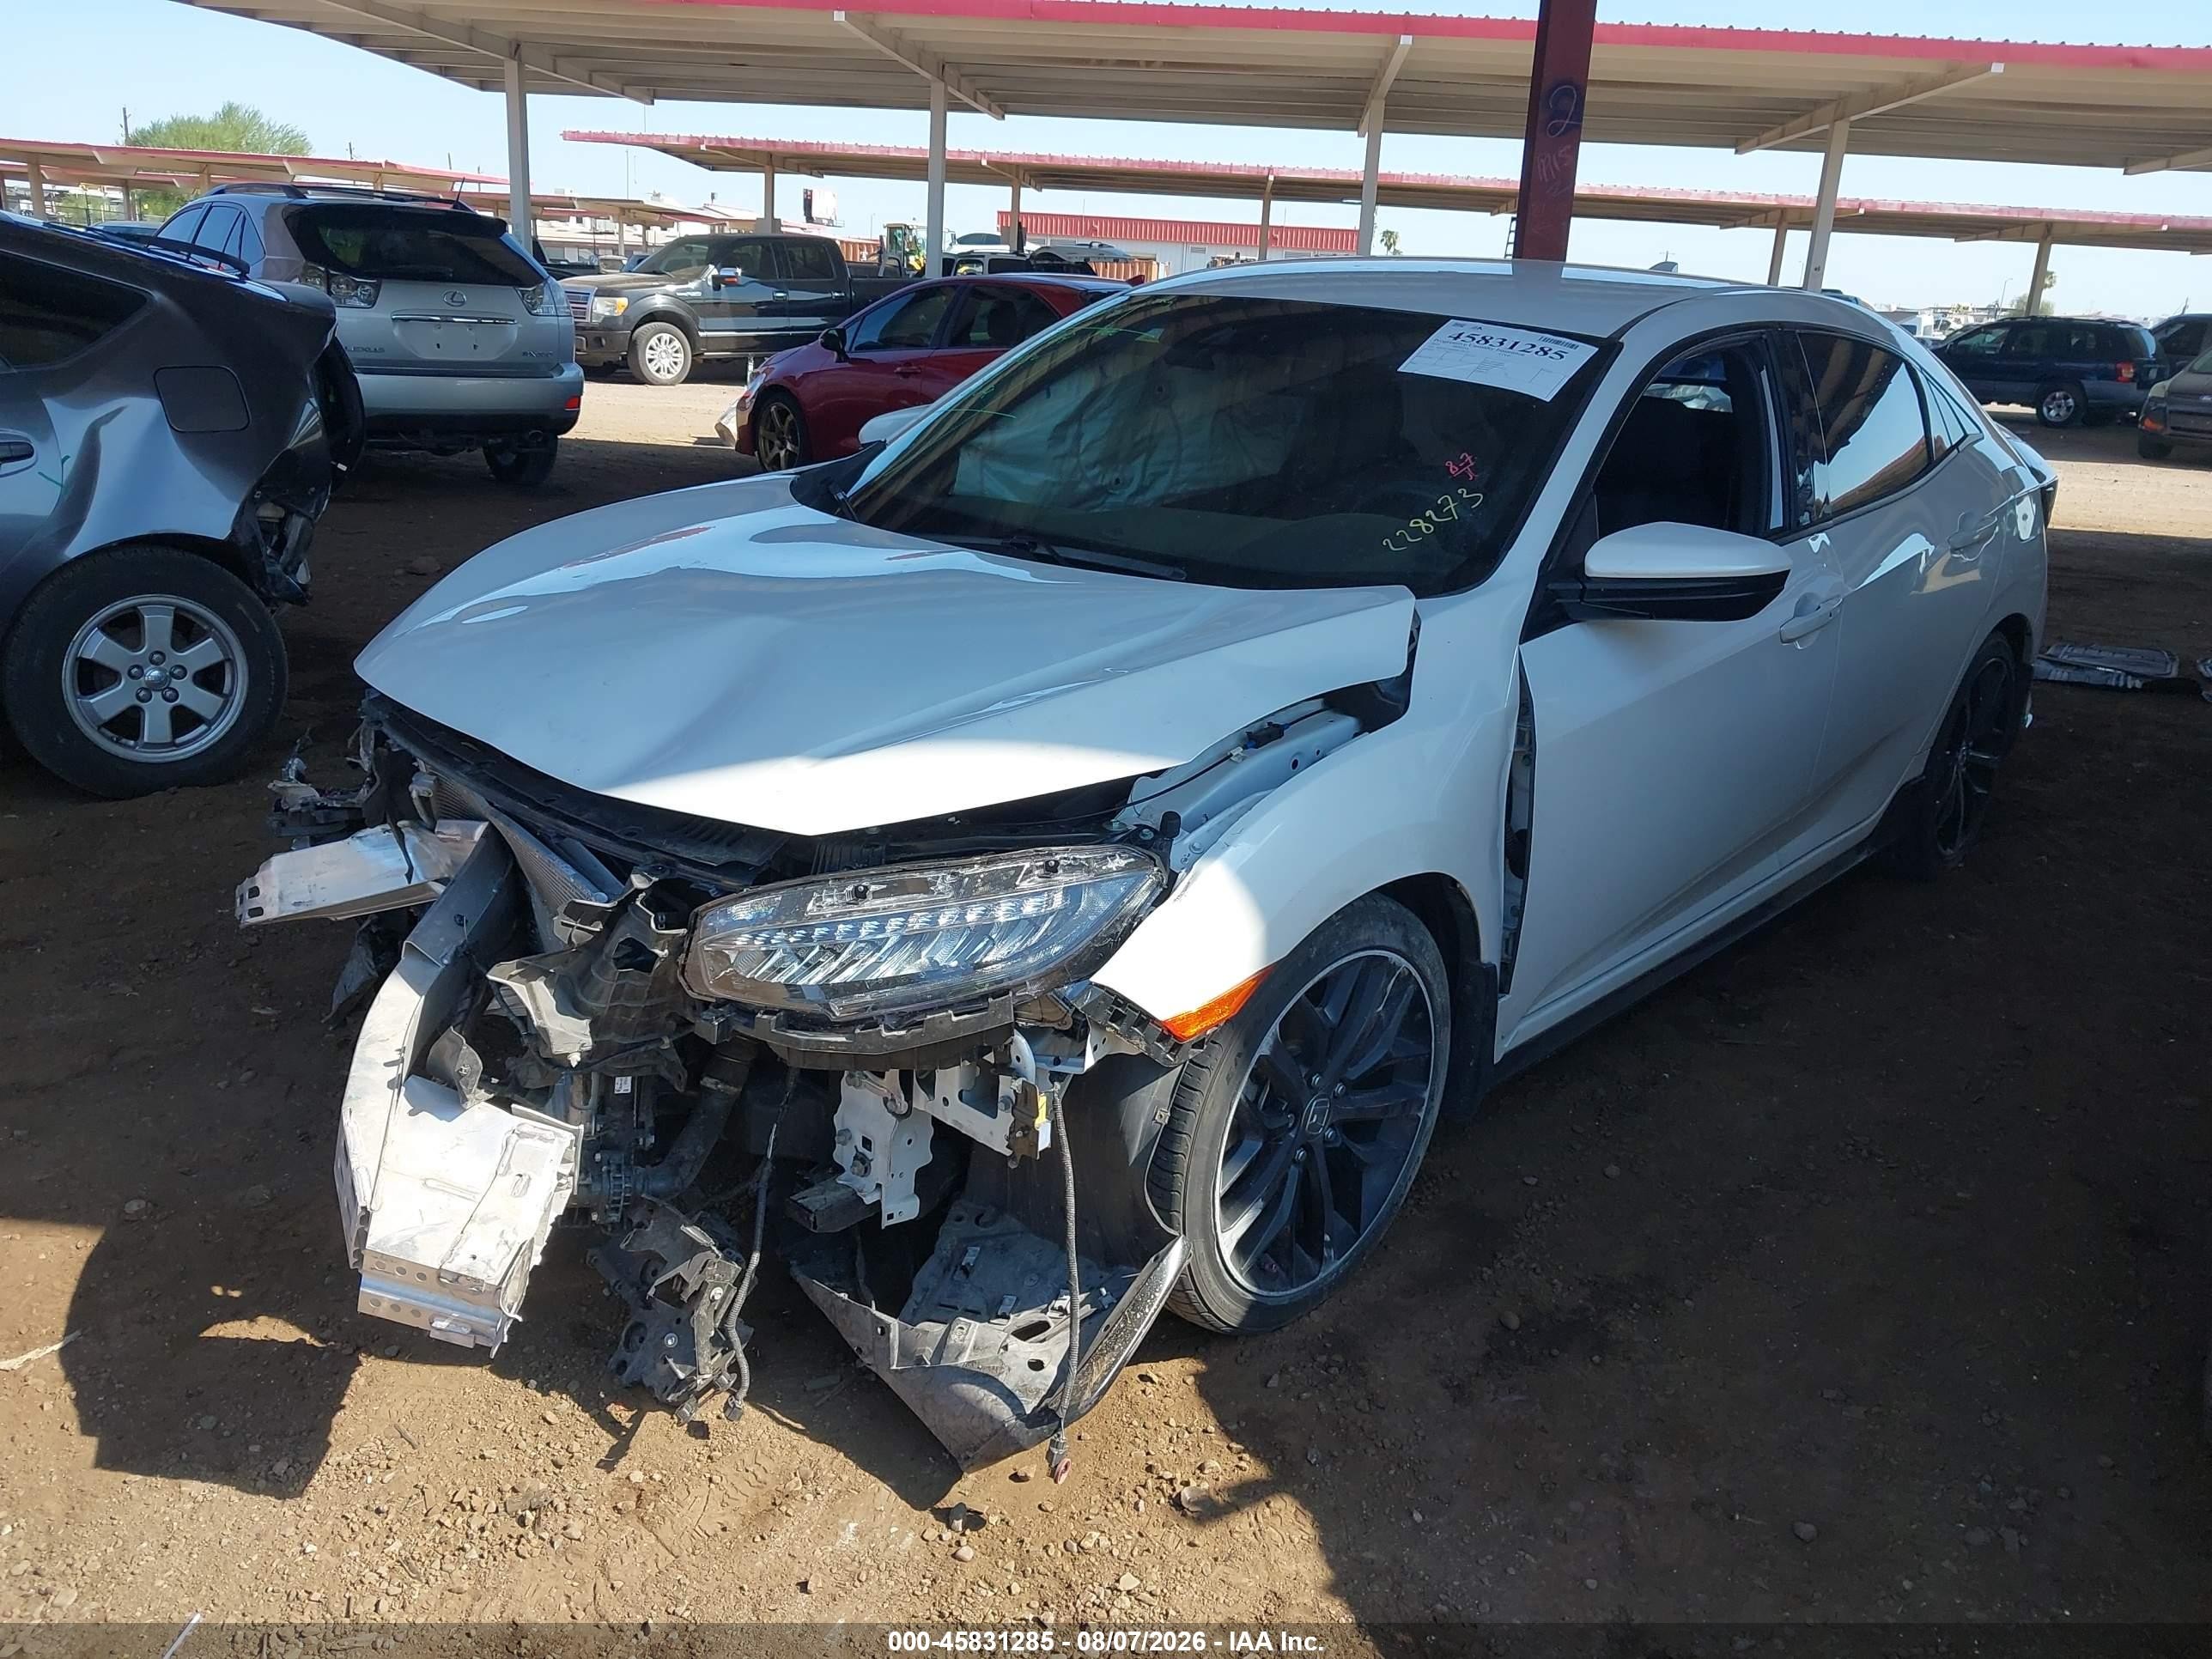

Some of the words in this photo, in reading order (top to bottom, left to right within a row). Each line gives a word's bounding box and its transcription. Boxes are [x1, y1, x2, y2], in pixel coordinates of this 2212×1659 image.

[1546, 84, 1583, 138] 2
[1448, 331, 1570, 361] 45831285
[1382, 487, 1484, 551] 228273
